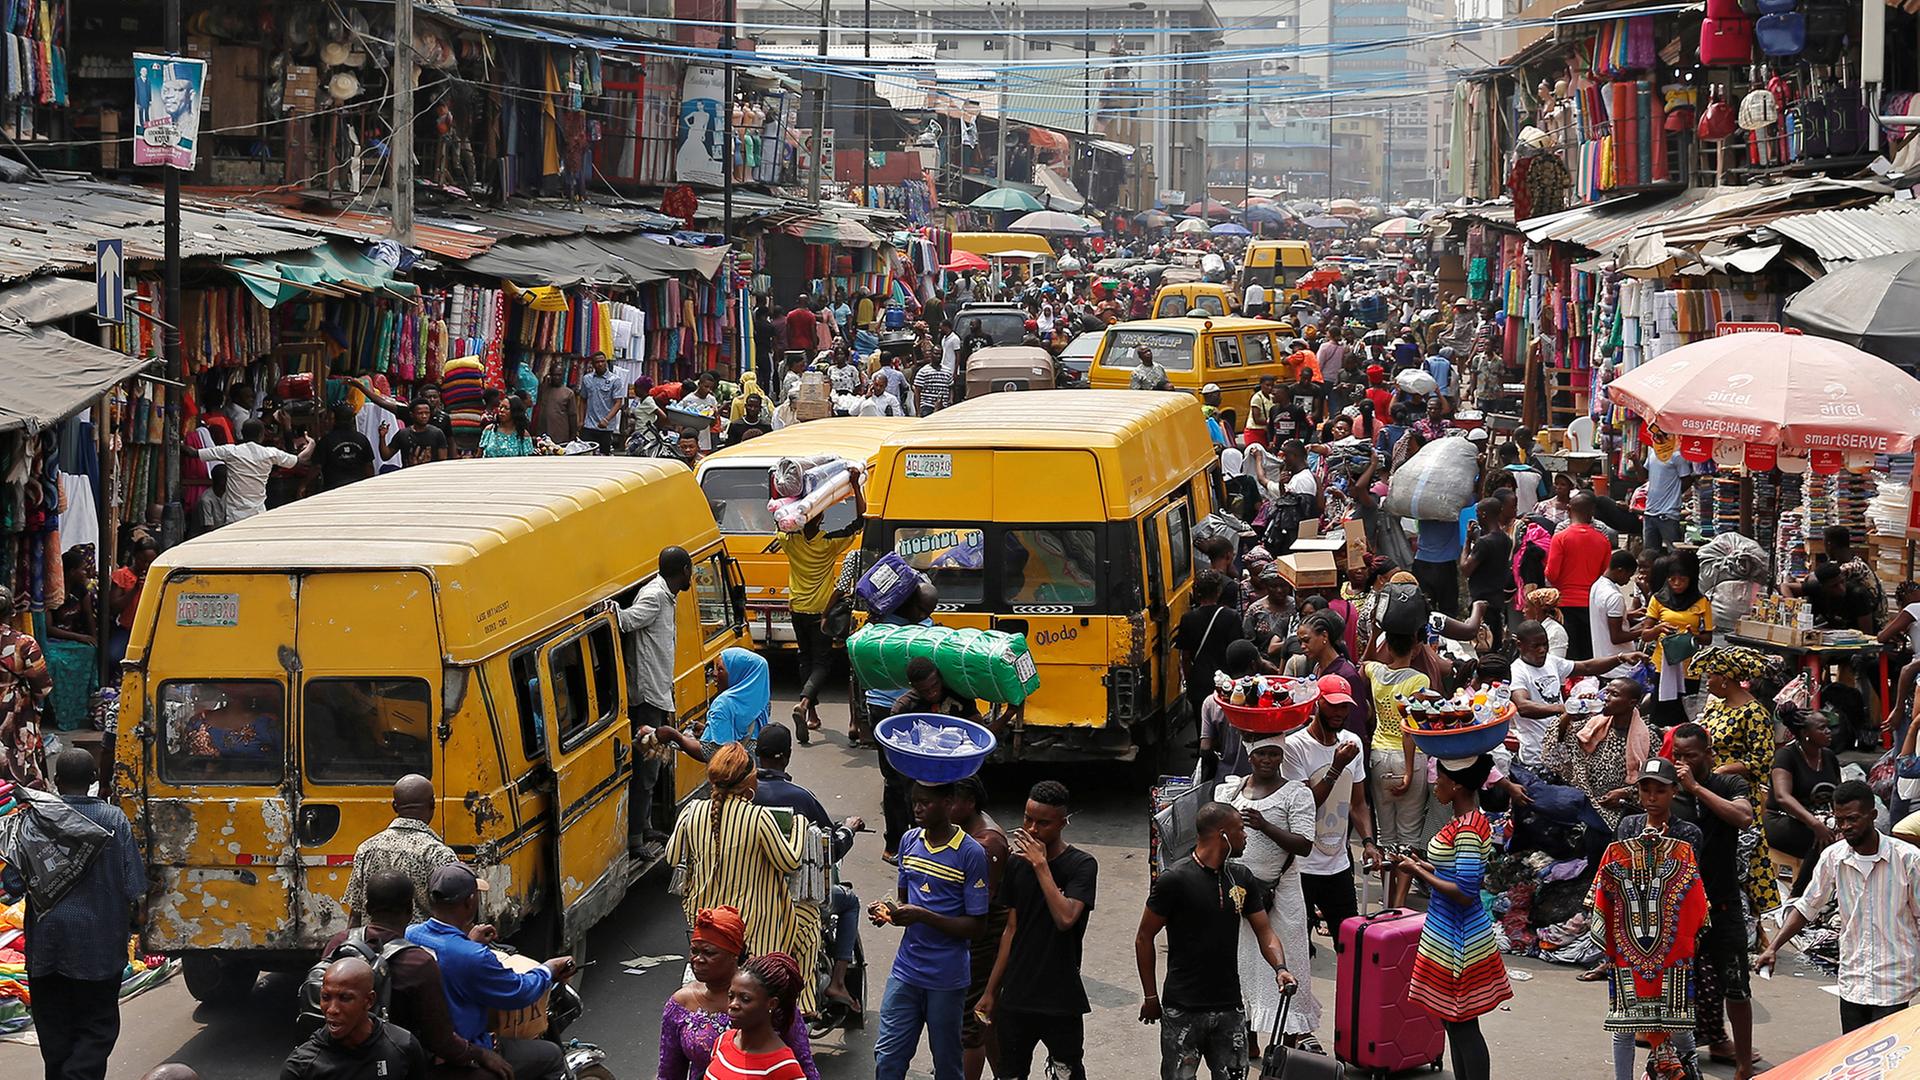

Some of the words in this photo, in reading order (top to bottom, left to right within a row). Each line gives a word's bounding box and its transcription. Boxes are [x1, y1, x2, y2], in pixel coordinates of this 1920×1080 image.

[1707, 390, 1751, 405] airtel
[1820, 402, 1865, 417] airtel
[1681, 418, 1762, 437] easyRECHARGE
[1804, 433, 1888, 451] smartSERVE
